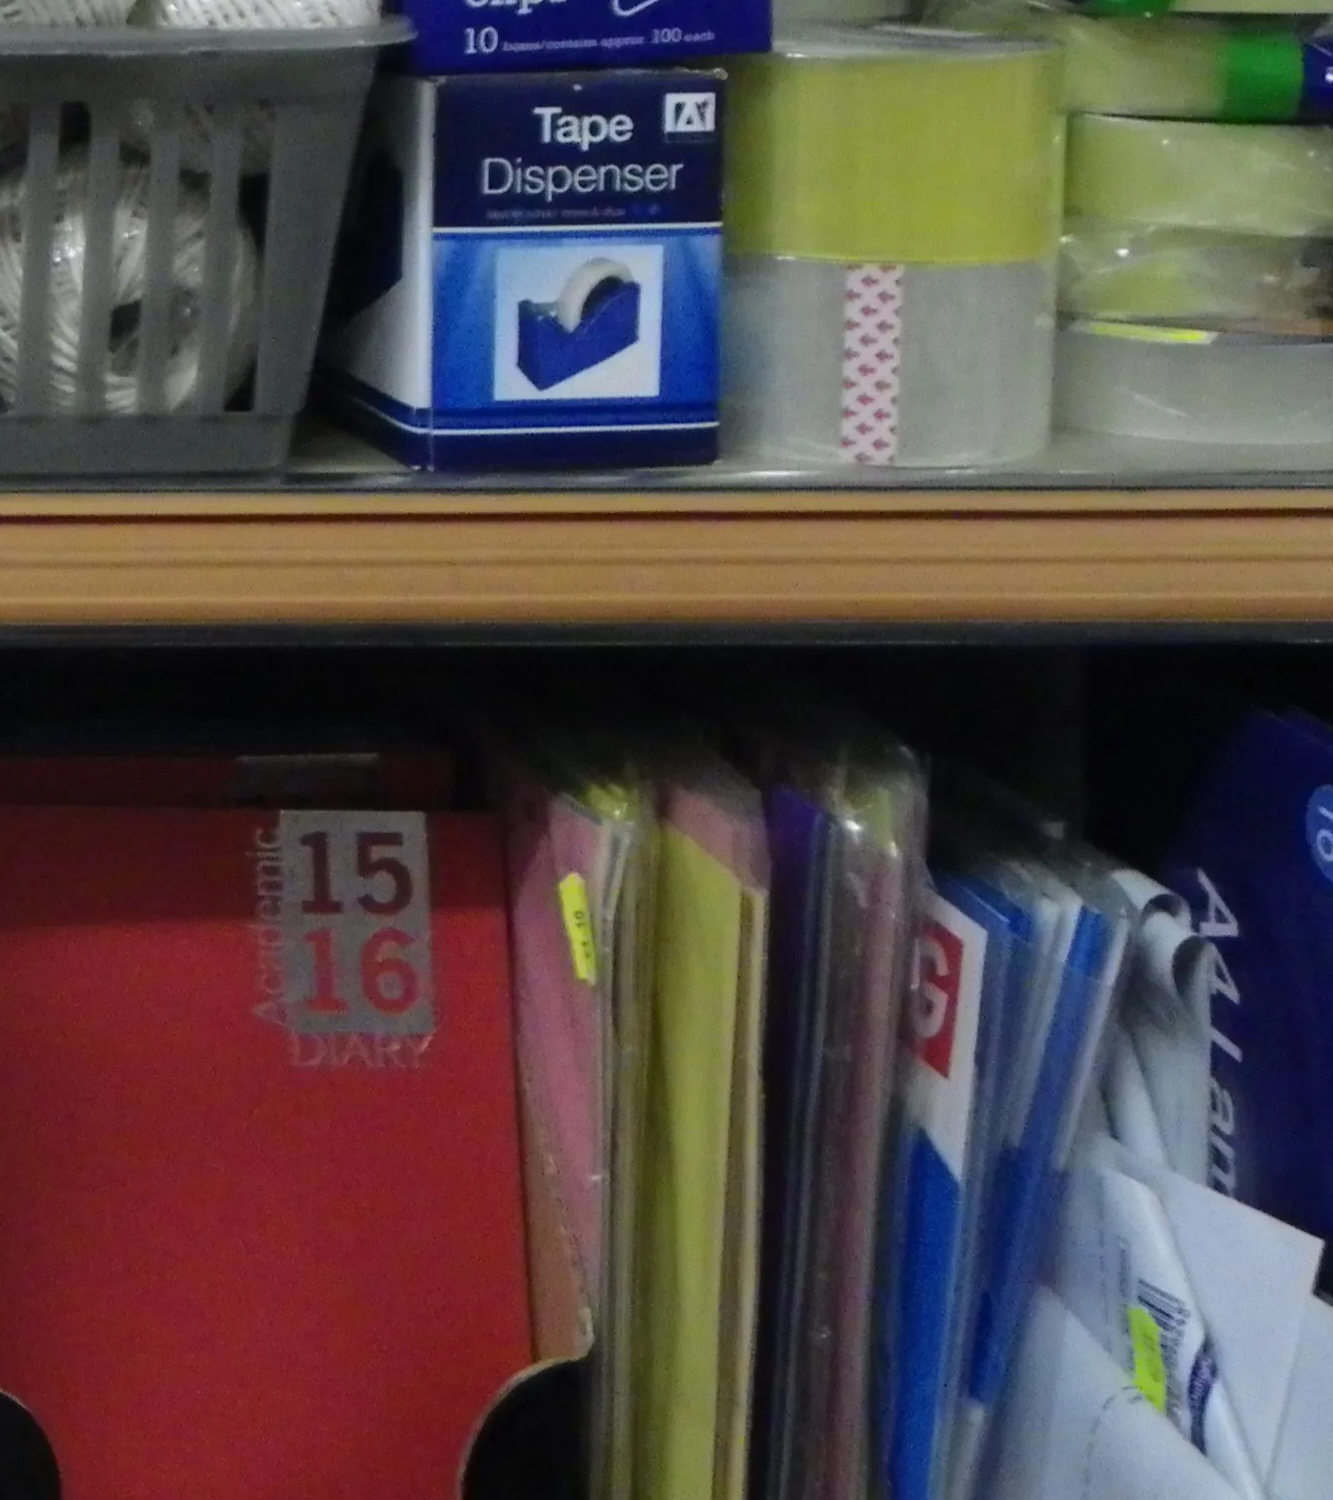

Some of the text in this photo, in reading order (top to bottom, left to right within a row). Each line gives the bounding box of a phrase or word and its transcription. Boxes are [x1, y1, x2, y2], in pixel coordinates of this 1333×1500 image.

[464, 27, 500, 56] 10
[533, 107, 635, 151] Tape
[481, 157, 684, 202] Dispenser
[300, 831, 413, 917] 15
[303, 928, 421, 1016] 16
